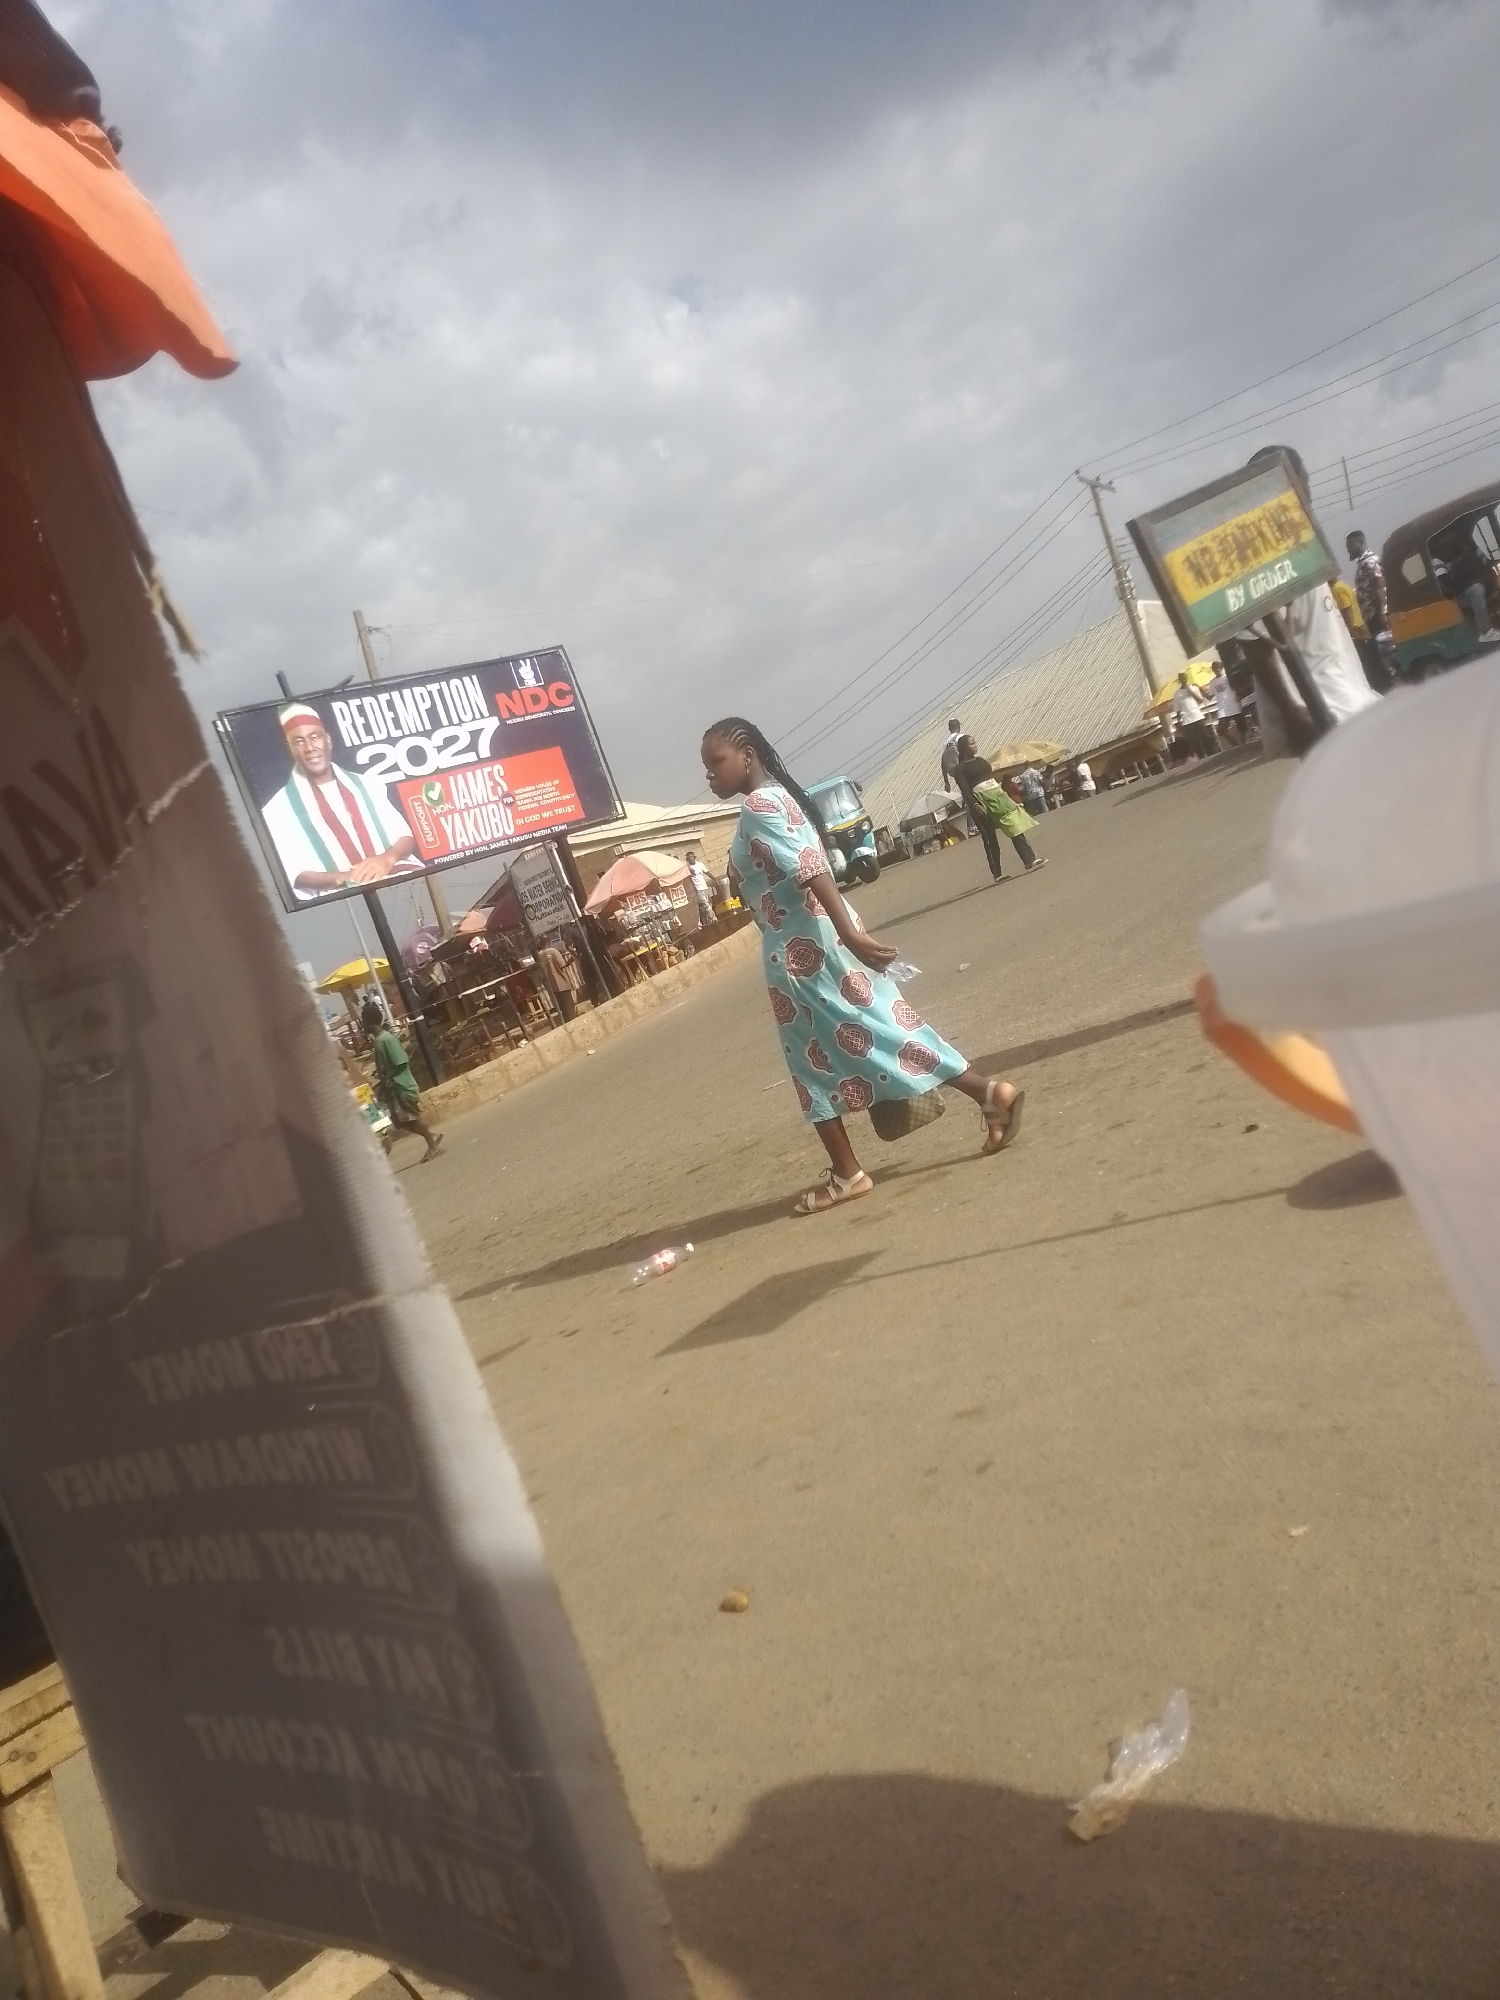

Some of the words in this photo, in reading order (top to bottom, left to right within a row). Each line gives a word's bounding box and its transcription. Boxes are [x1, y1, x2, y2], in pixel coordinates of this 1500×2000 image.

[1226, 584, 1246, 613] BY
[331, 674, 490, 748] REDEMPTION
[495, 681, 574, 719] NDC
[356, 716, 500, 784] 2027
[432, 801, 455, 816] HON.
[449, 764, 508, 811] JAMES
[503, 796, 515, 805] FOR
[514, 785, 536, 795] MEMBER
[536, 781, 552, 790] HOUSE
[518, 802, 541, 812] FEDERAL
[413, 801, 435, 843] SUPPORT
[440, 801, 515, 851] YAKUBU
[516, 818, 525, 826] IN
[525, 813, 541, 823] GOD
[541, 810, 554, 819] WE
[554, 804, 576, 816] TRUST
[434, 852, 464, 864] POWERED
[465, 848, 475, 857] BY
[474, 844, 490, 854] HON.
[489, 840, 509, 850] JAMES
[509, 834, 532, 844] YAKUBU
[533, 829, 551, 838] MEDIA
[551, 823, 568, 833] TEAM
[628, 892, 647, 907] POS
